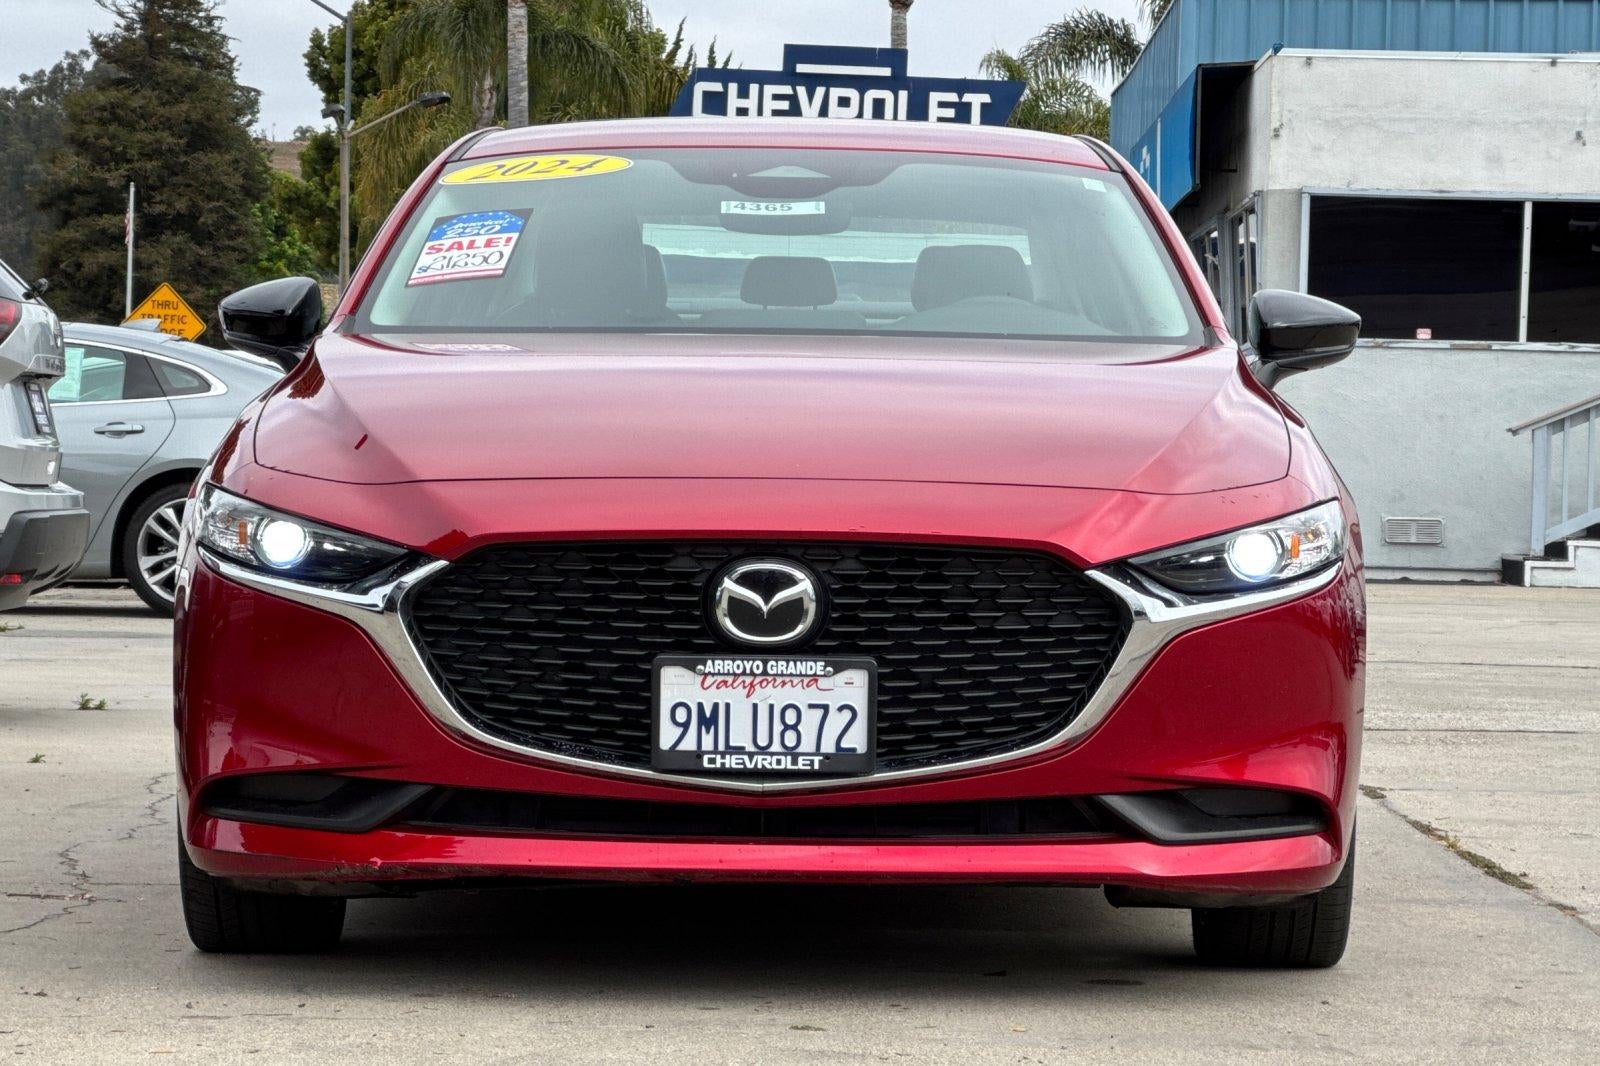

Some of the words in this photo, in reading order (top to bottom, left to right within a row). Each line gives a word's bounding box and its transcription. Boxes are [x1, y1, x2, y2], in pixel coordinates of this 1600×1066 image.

[692, 81, 992, 125] CHEVROLET
[463, 157, 608, 181] 2024
[733, 202, 793, 212] 4365
[442, 224, 502, 239] 250
[425, 237, 513, 255] SALE!
[151, 299, 179, 310] THRU
[704, 659, 764, 675] ARROYO
[767, 660, 825, 676] GRANDE
[700, 673, 834, 699] California
[669, 701, 859, 754] 9MLU872
[702, 753, 823, 770] CHEVROLET
